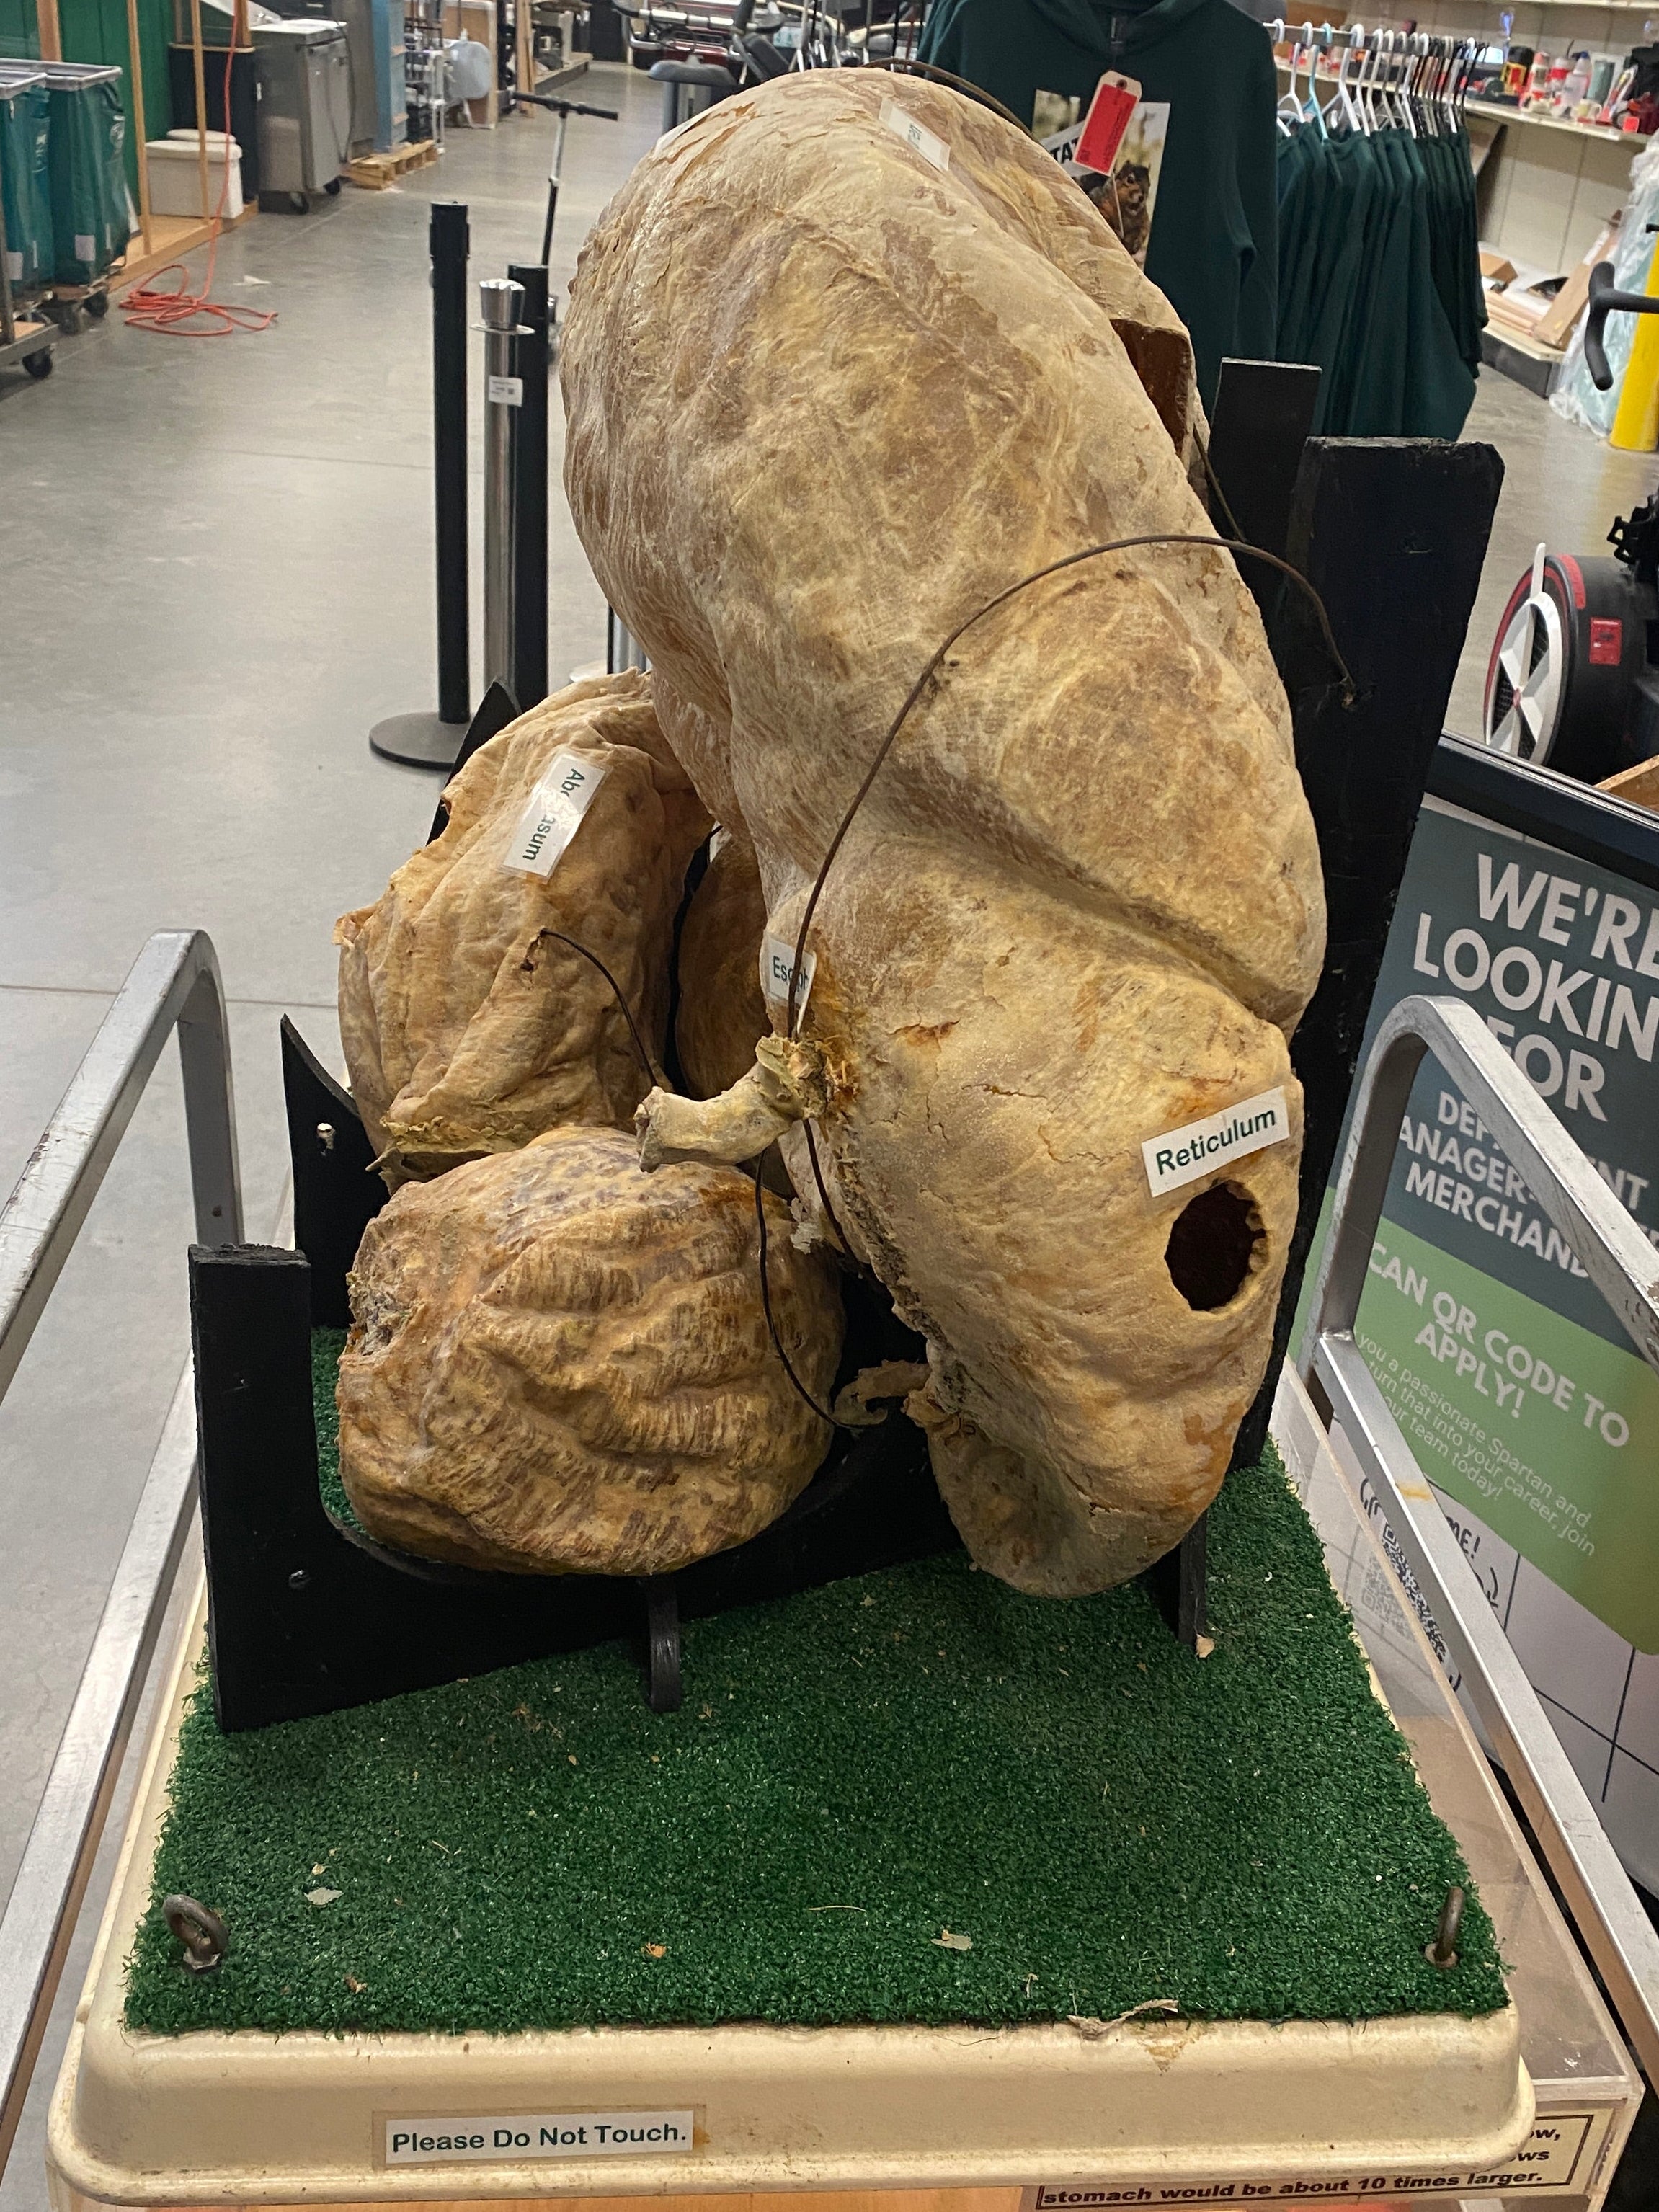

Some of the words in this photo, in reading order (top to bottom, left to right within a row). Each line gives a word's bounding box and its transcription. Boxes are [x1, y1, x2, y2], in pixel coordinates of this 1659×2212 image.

[1413, 912, 1659, 1062] LOOKIN
[1156, 1110, 1276, 1175] Reticulum
[1400, 1115, 1537, 1205] ANAGER
[1370, 1243, 1428, 1305] CAN
[1433, 1292, 1477, 1344] QR
[1485, 1330, 1576, 1413] CODE
[1583, 1393, 1630, 1447] TO
[1414, 1322, 1525, 1418] APPLY!
[1358, 1334, 1384, 1362] you
[1388, 1359, 1399, 1372] a
[1400, 1368, 1486, 1443] passionate
[1487, 1437, 1554, 1498] Spartan
[1555, 1495, 1592, 1527] and
[1400, 1387, 1431, 1421] that
[1432, 1415, 1463, 1446] into
[1463, 1442, 1503, 1477] your
[1503, 1475, 1558, 1530] career,
[1557, 1521, 1596, 1557] join
[1409, 1417, 1449, 1458] team
[1451, 1452, 1504, 1501] today!
[392, 2133, 485, 2154] Please
[493, 2129, 530, 2149] Do
[539, 2126, 588, 2146] Not
[593, 2123, 686, 2144] Touch.
[1529, 2128, 1561, 2142] w,
[1044, 2187, 1152, 2206] stomach
[1159, 2184, 1235, 2200] would
[1242, 2182, 1271, 2196] be
[1279, 2179, 1350, 2194] about
[1358, 2177, 1387, 2190] 10
[1393, 2174, 1460, 2189] times
[1467, 2172, 1542, 2187] larger.
